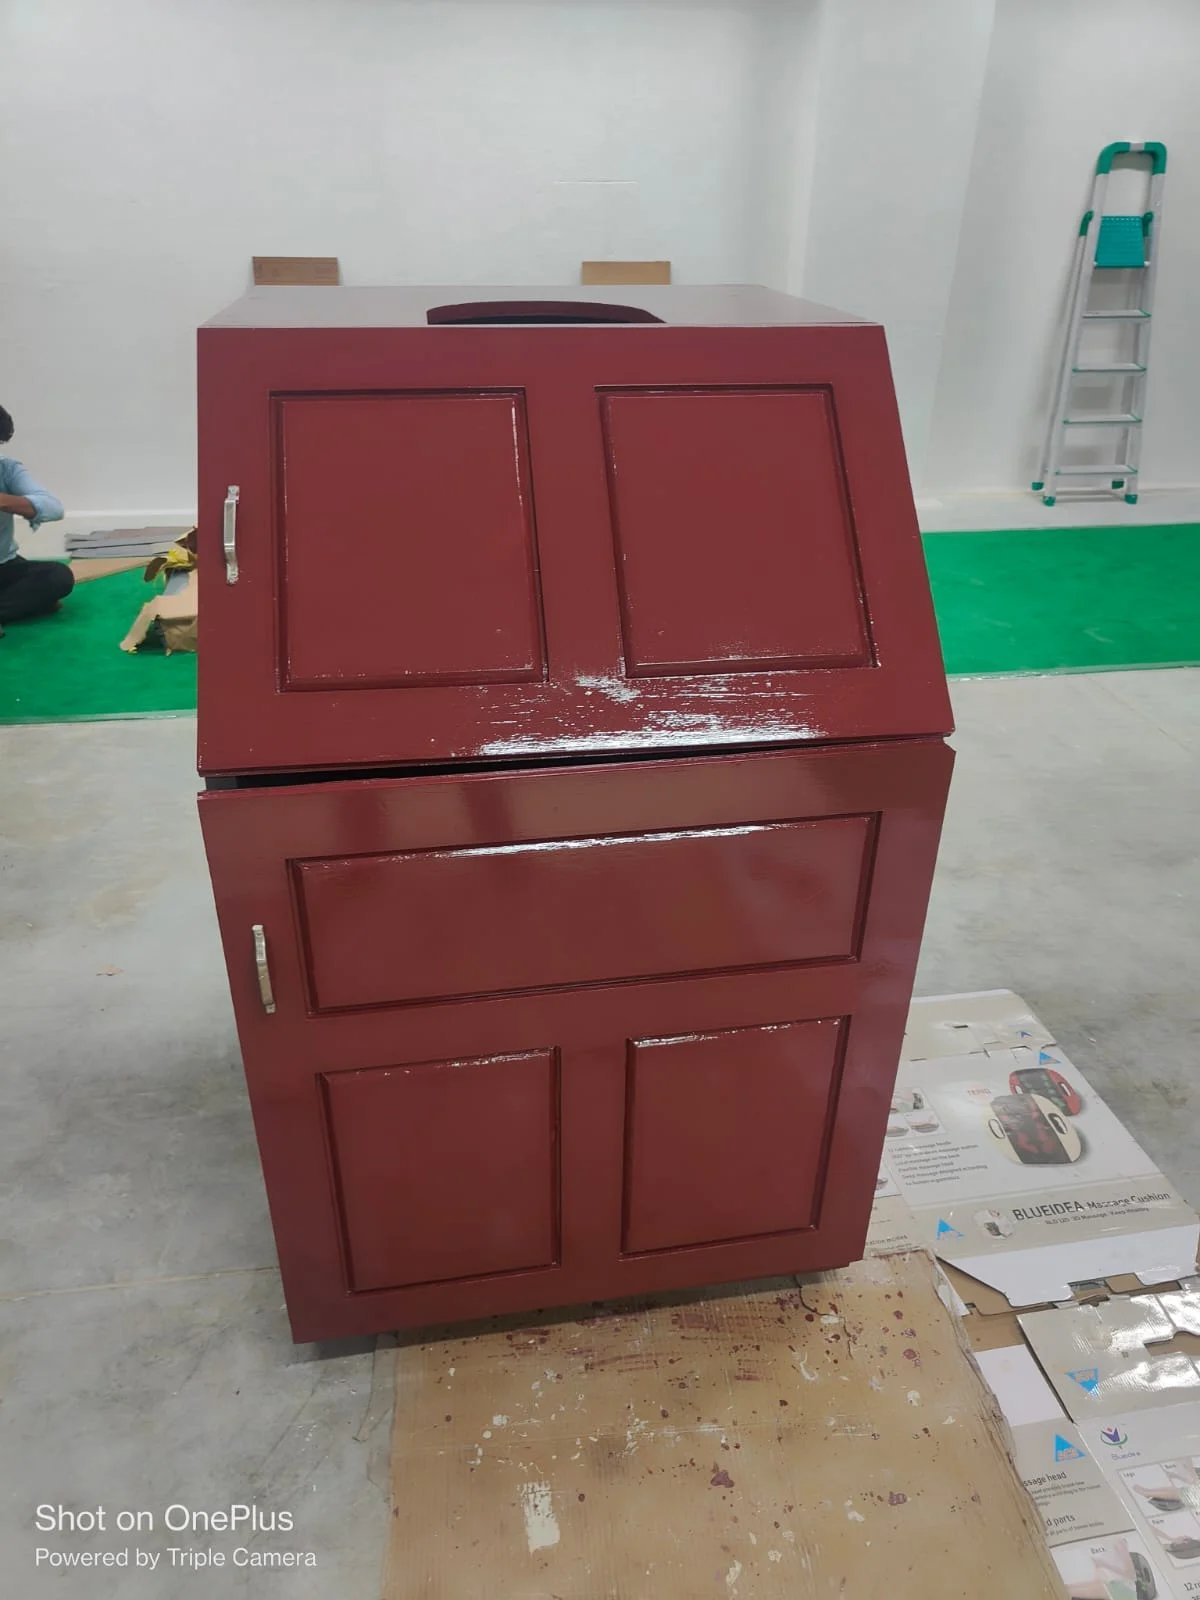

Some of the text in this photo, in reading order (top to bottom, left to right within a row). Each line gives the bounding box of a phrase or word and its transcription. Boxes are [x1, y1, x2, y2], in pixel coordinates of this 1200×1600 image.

[1011, 1200, 1084, 1221] BLUEIDEA
[1130, 1191, 1171, 1204] Cushion
[1023, 1471, 1068, 1487] ssage head
[1053, 1514, 1076, 1527] parts
